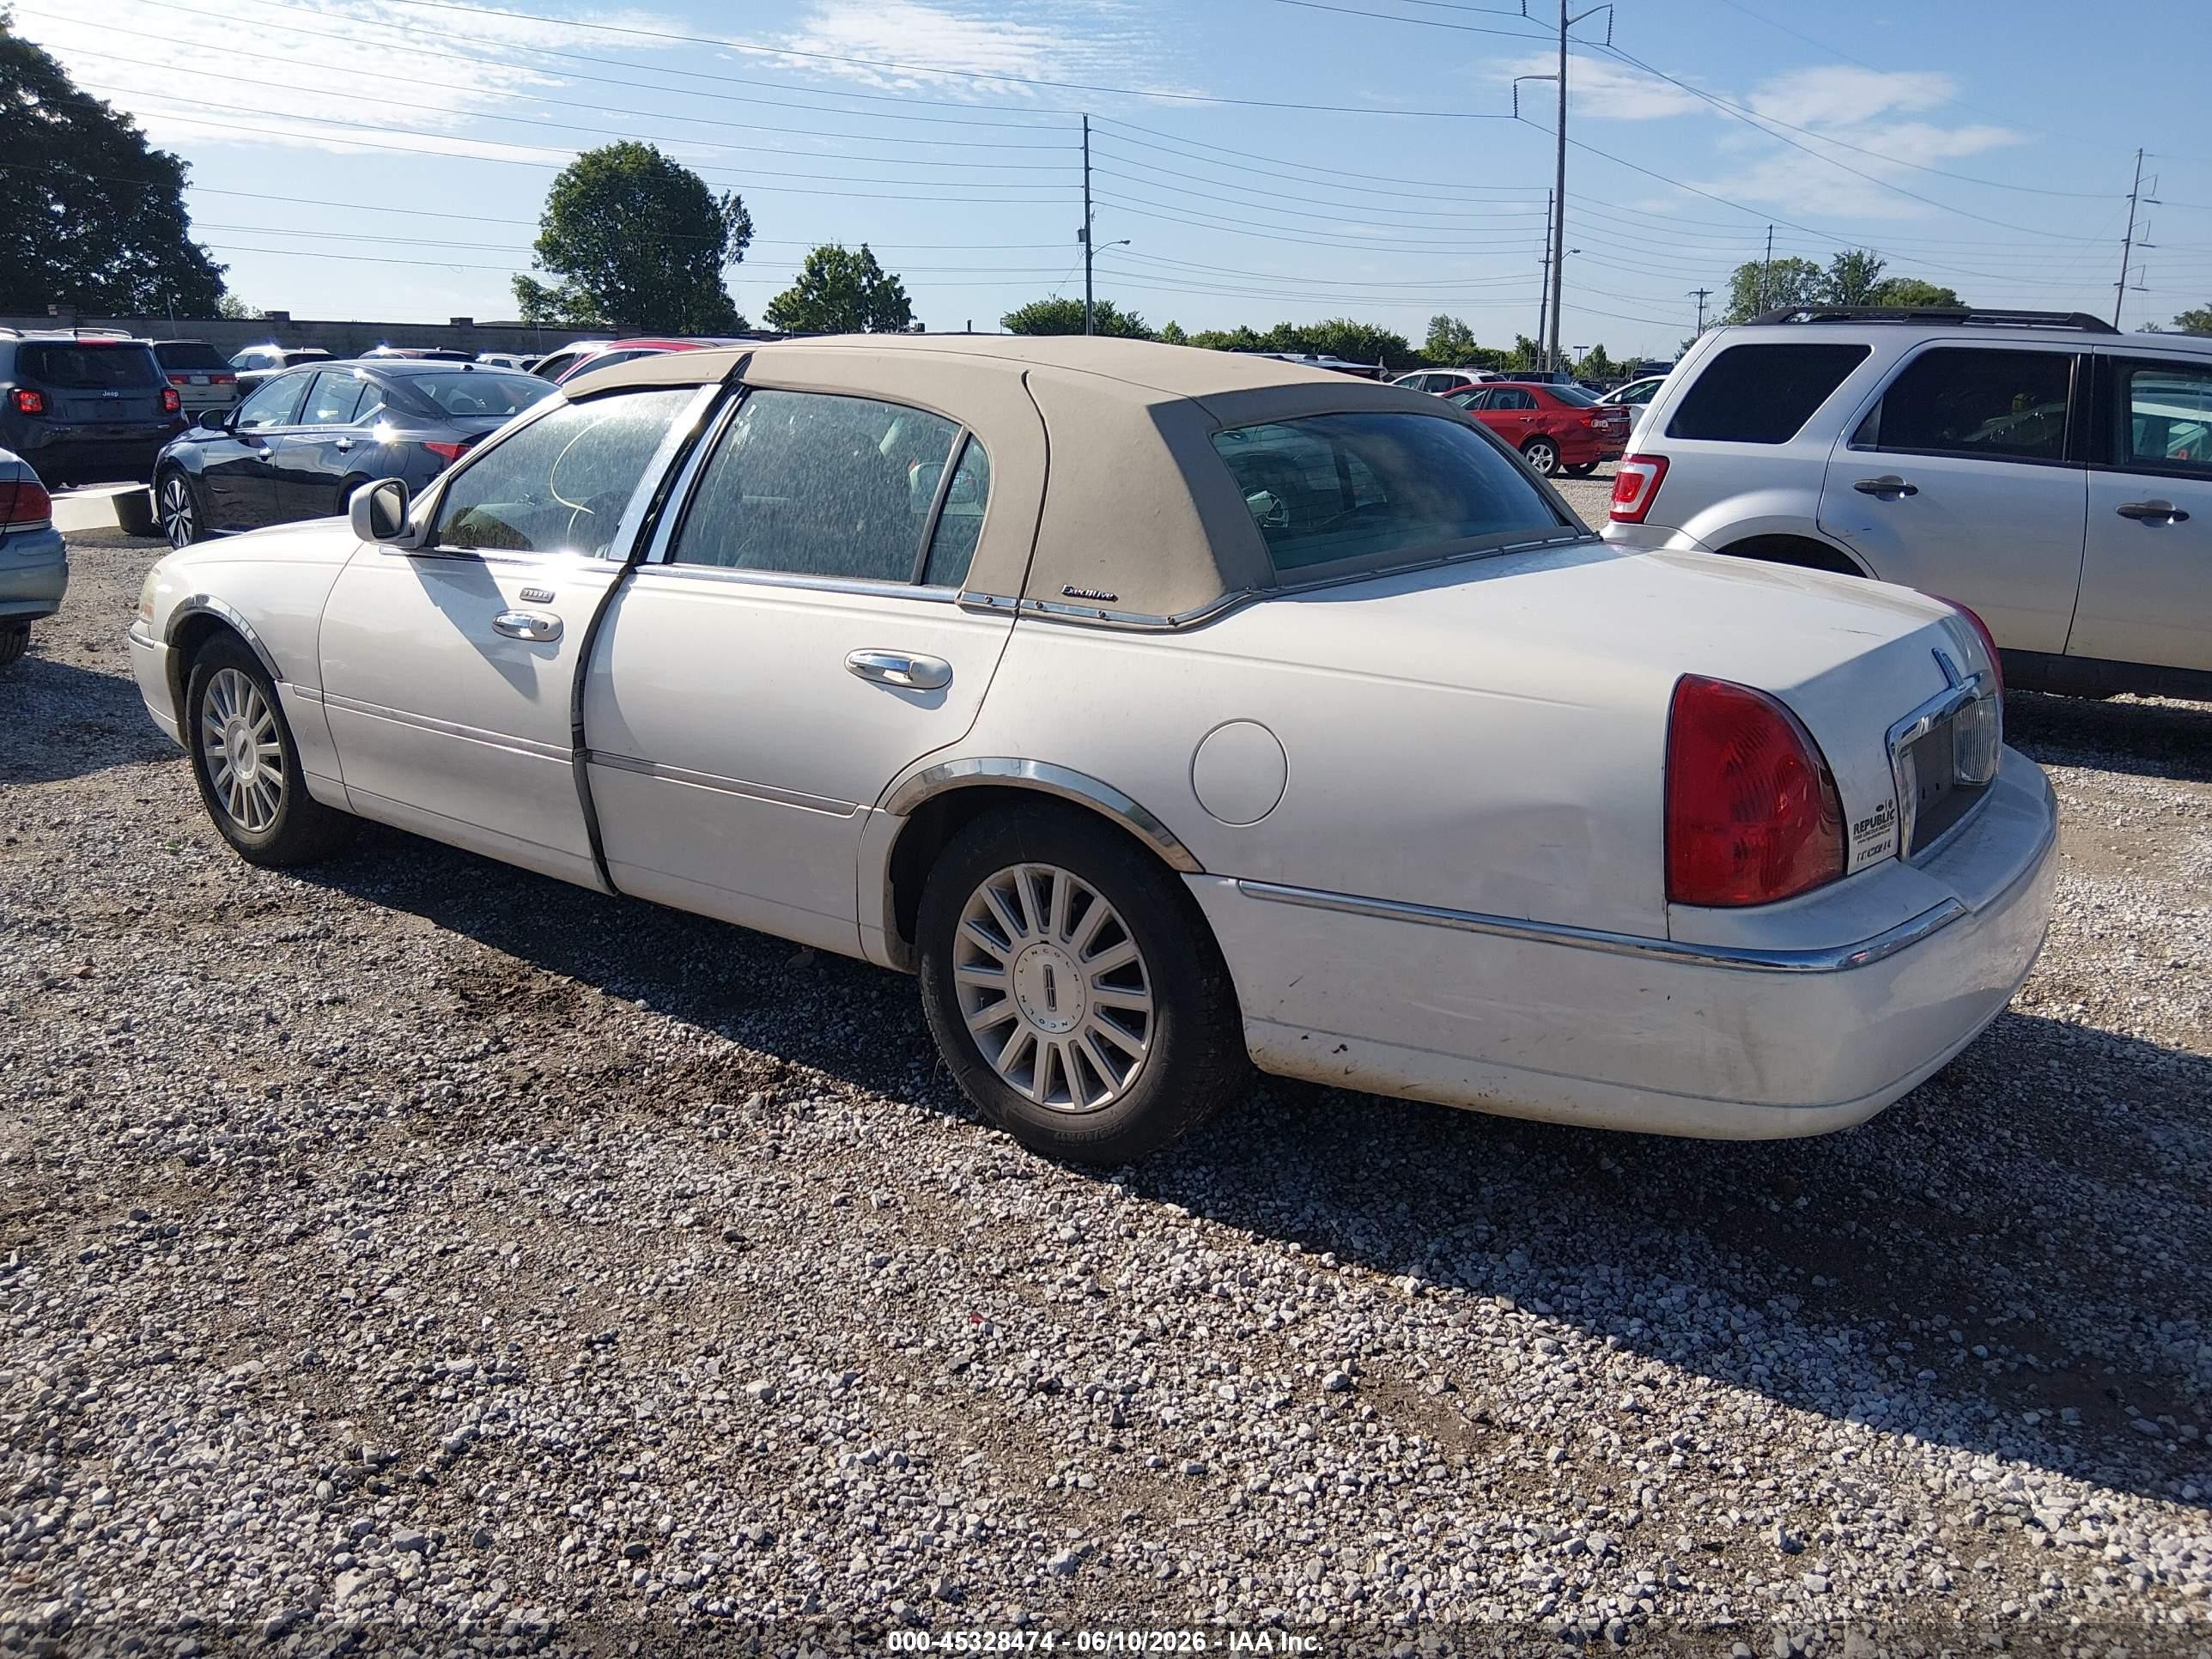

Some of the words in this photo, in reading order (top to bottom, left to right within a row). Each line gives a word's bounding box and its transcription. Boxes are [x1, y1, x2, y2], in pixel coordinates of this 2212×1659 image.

[1060, 584, 1116, 599] Executive
[1853, 808, 1895, 836] REPUBLIC
[1018, 948, 1079, 981] LINCOLN
